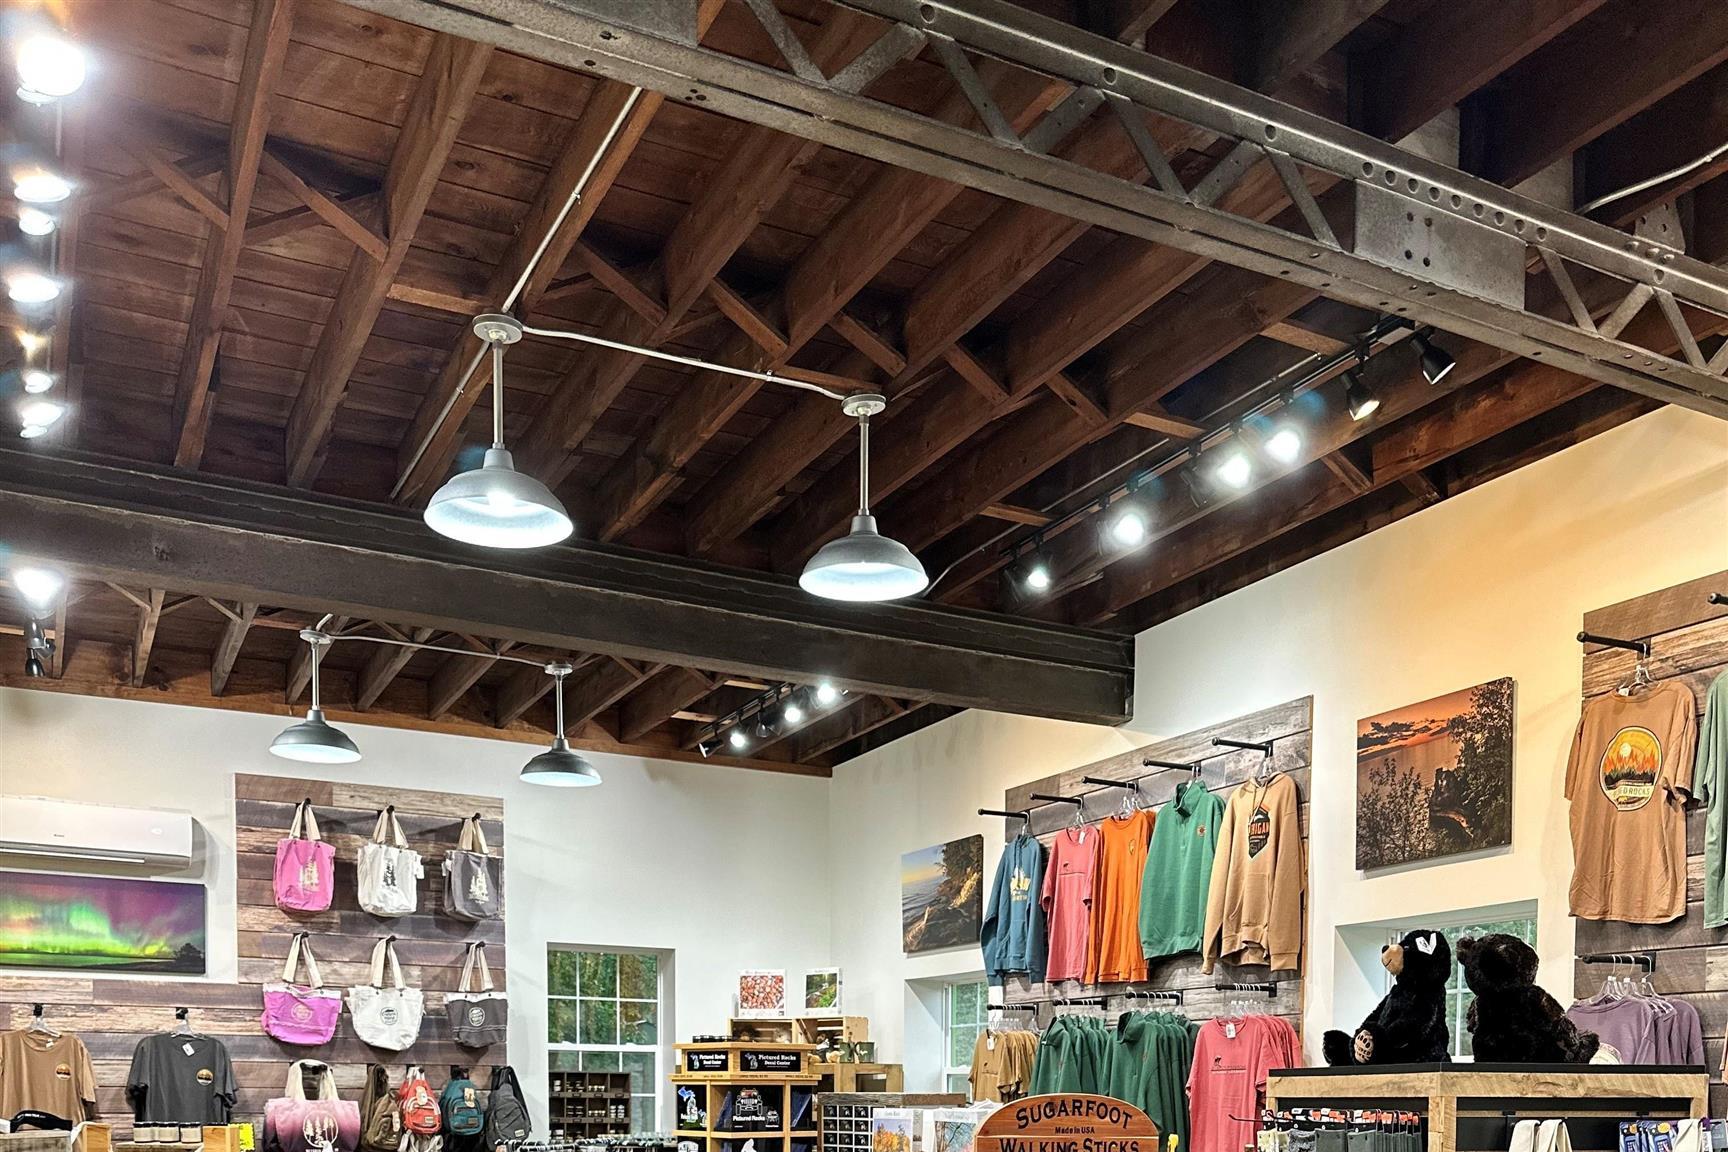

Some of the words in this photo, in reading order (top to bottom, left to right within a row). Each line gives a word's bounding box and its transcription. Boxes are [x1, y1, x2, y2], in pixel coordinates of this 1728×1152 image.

[1016, 1099, 1133, 1130] SUGARFOOT
[1055, 1126, 1073, 1134] Made
[1073, 1126, 1080, 1134] in
[1081, 1126, 1095, 1134] USA
